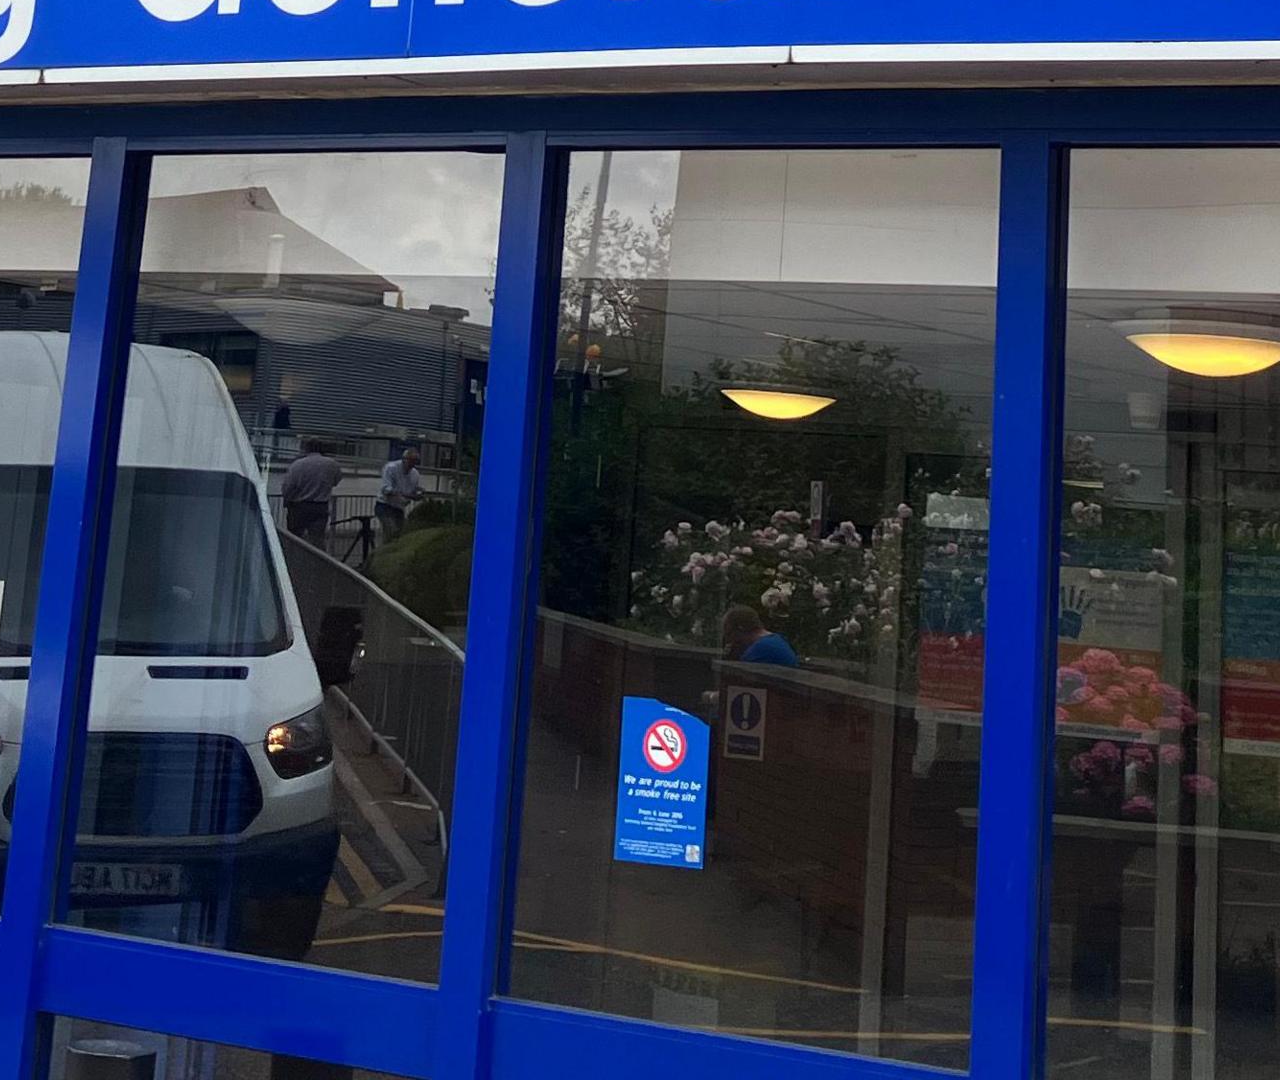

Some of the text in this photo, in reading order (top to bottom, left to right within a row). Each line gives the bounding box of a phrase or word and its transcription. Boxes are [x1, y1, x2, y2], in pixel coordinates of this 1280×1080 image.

[624, 774, 702, 792] We are proud to be
[627, 788, 696, 803] a smoke free site
